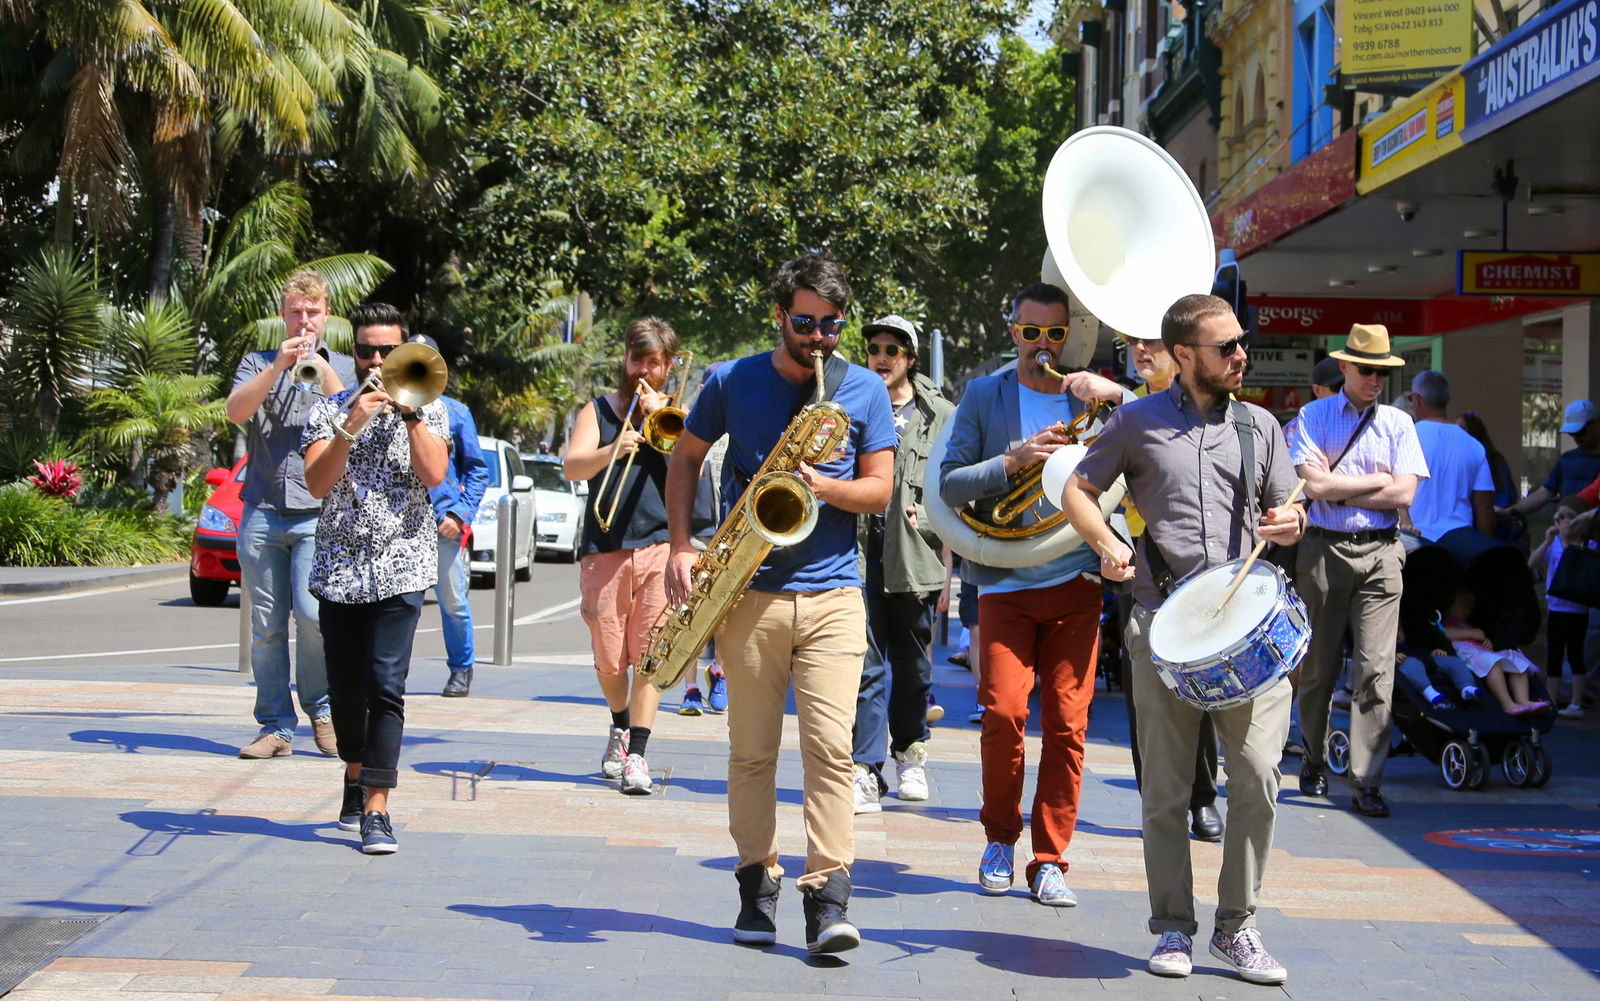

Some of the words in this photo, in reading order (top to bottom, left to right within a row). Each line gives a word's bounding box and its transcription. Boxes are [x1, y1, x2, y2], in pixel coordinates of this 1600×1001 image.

[1353, 10, 1382, 20] Vincent
[1384, 8, 1403, 18] West
[1405, 6, 1425, 15] 0403
[1427, 5, 1442, 13] 444
[1444, 3, 1460, 12] 000
[1353, 24, 1373, 34] Toby
[1391, 21, 1411, 30] 0422
[1413, 20, 1427, 29] 143
[1428, 18, 1443, 27] 813
[1353, 40, 1375, 51] 9939
[1377, 39, 1400, 50] 6788
[1352, 46, 1462, 62] rhc.com.au/northernbeaches
[1485, 1, 1597, 115] AUSTRALIA'S
[1482, 264, 1576, 280] CHEMIST
[1257, 306, 1323, 326] george
[1372, 311, 1402, 322] ATM
